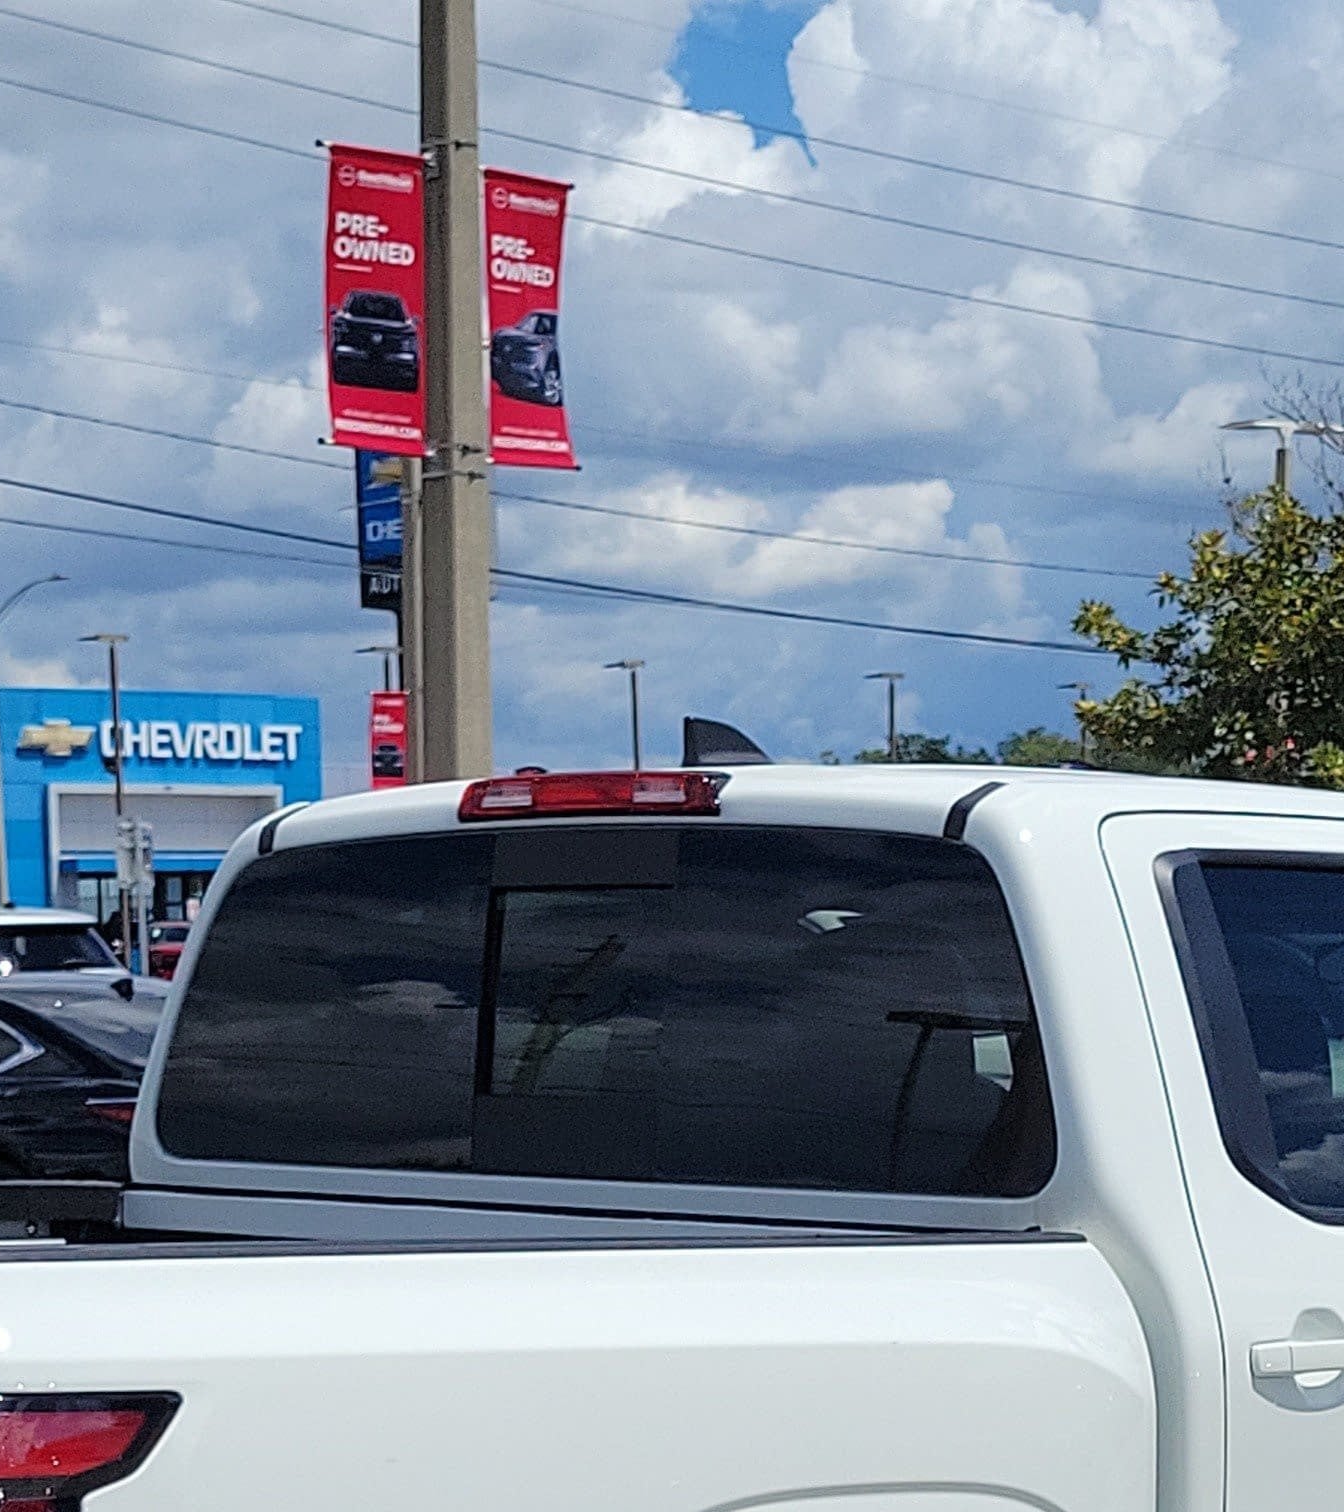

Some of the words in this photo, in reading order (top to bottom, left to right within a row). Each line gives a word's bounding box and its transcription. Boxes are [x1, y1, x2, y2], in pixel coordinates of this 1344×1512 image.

[334, 211, 389, 238] PRE-
[333, 237, 416, 266] OWNED
[491, 234, 535, 259] PRE-
[490, 257, 555, 288] OWNED
[100, 719, 303, 762] CHEVROLET
